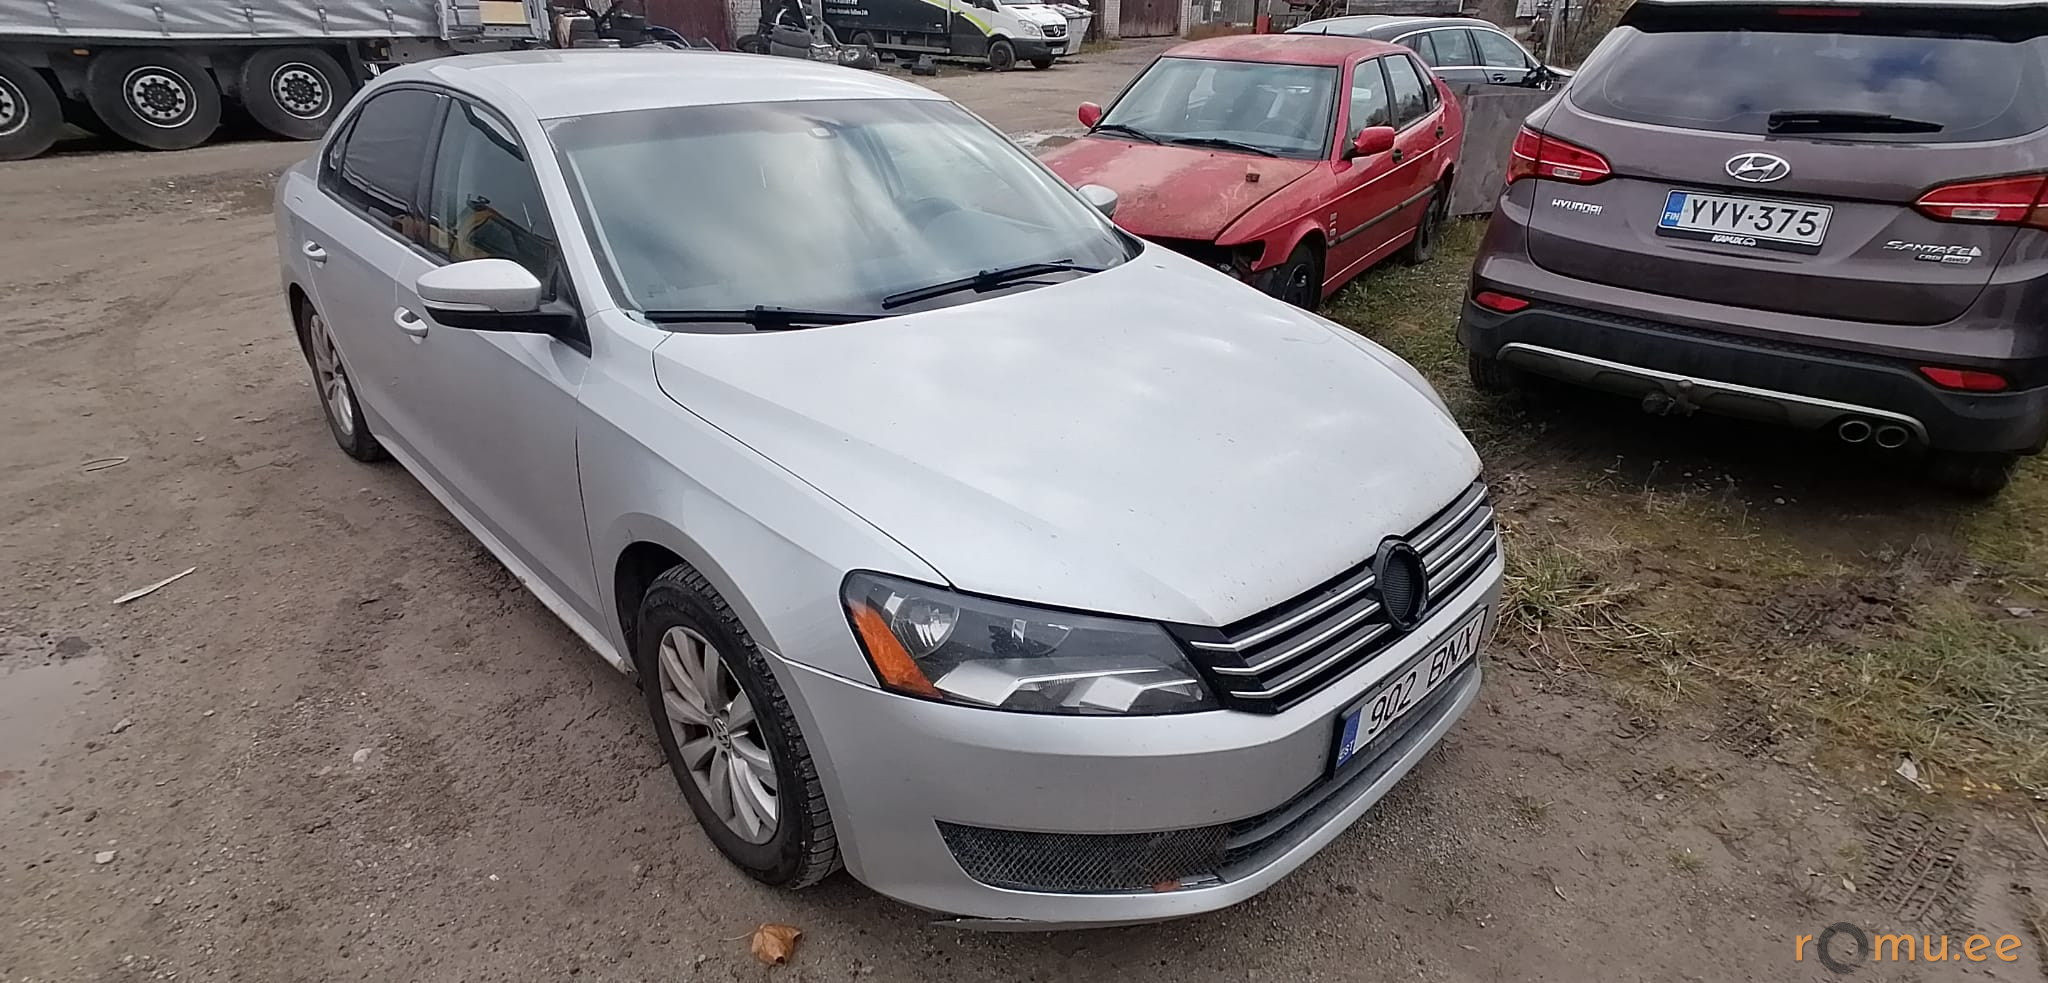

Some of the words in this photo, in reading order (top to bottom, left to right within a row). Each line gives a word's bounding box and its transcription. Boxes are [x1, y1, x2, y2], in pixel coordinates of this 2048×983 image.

[1552, 199, 1603, 216] HYUNDAI
[1664, 211, 1681, 221] FIN
[1690, 198, 1819, 237] YVV-375
[1338, 739, 1354, 760] EST
[1368, 671, 1417, 735] 902
[1427, 619, 1479, 689] BNX
